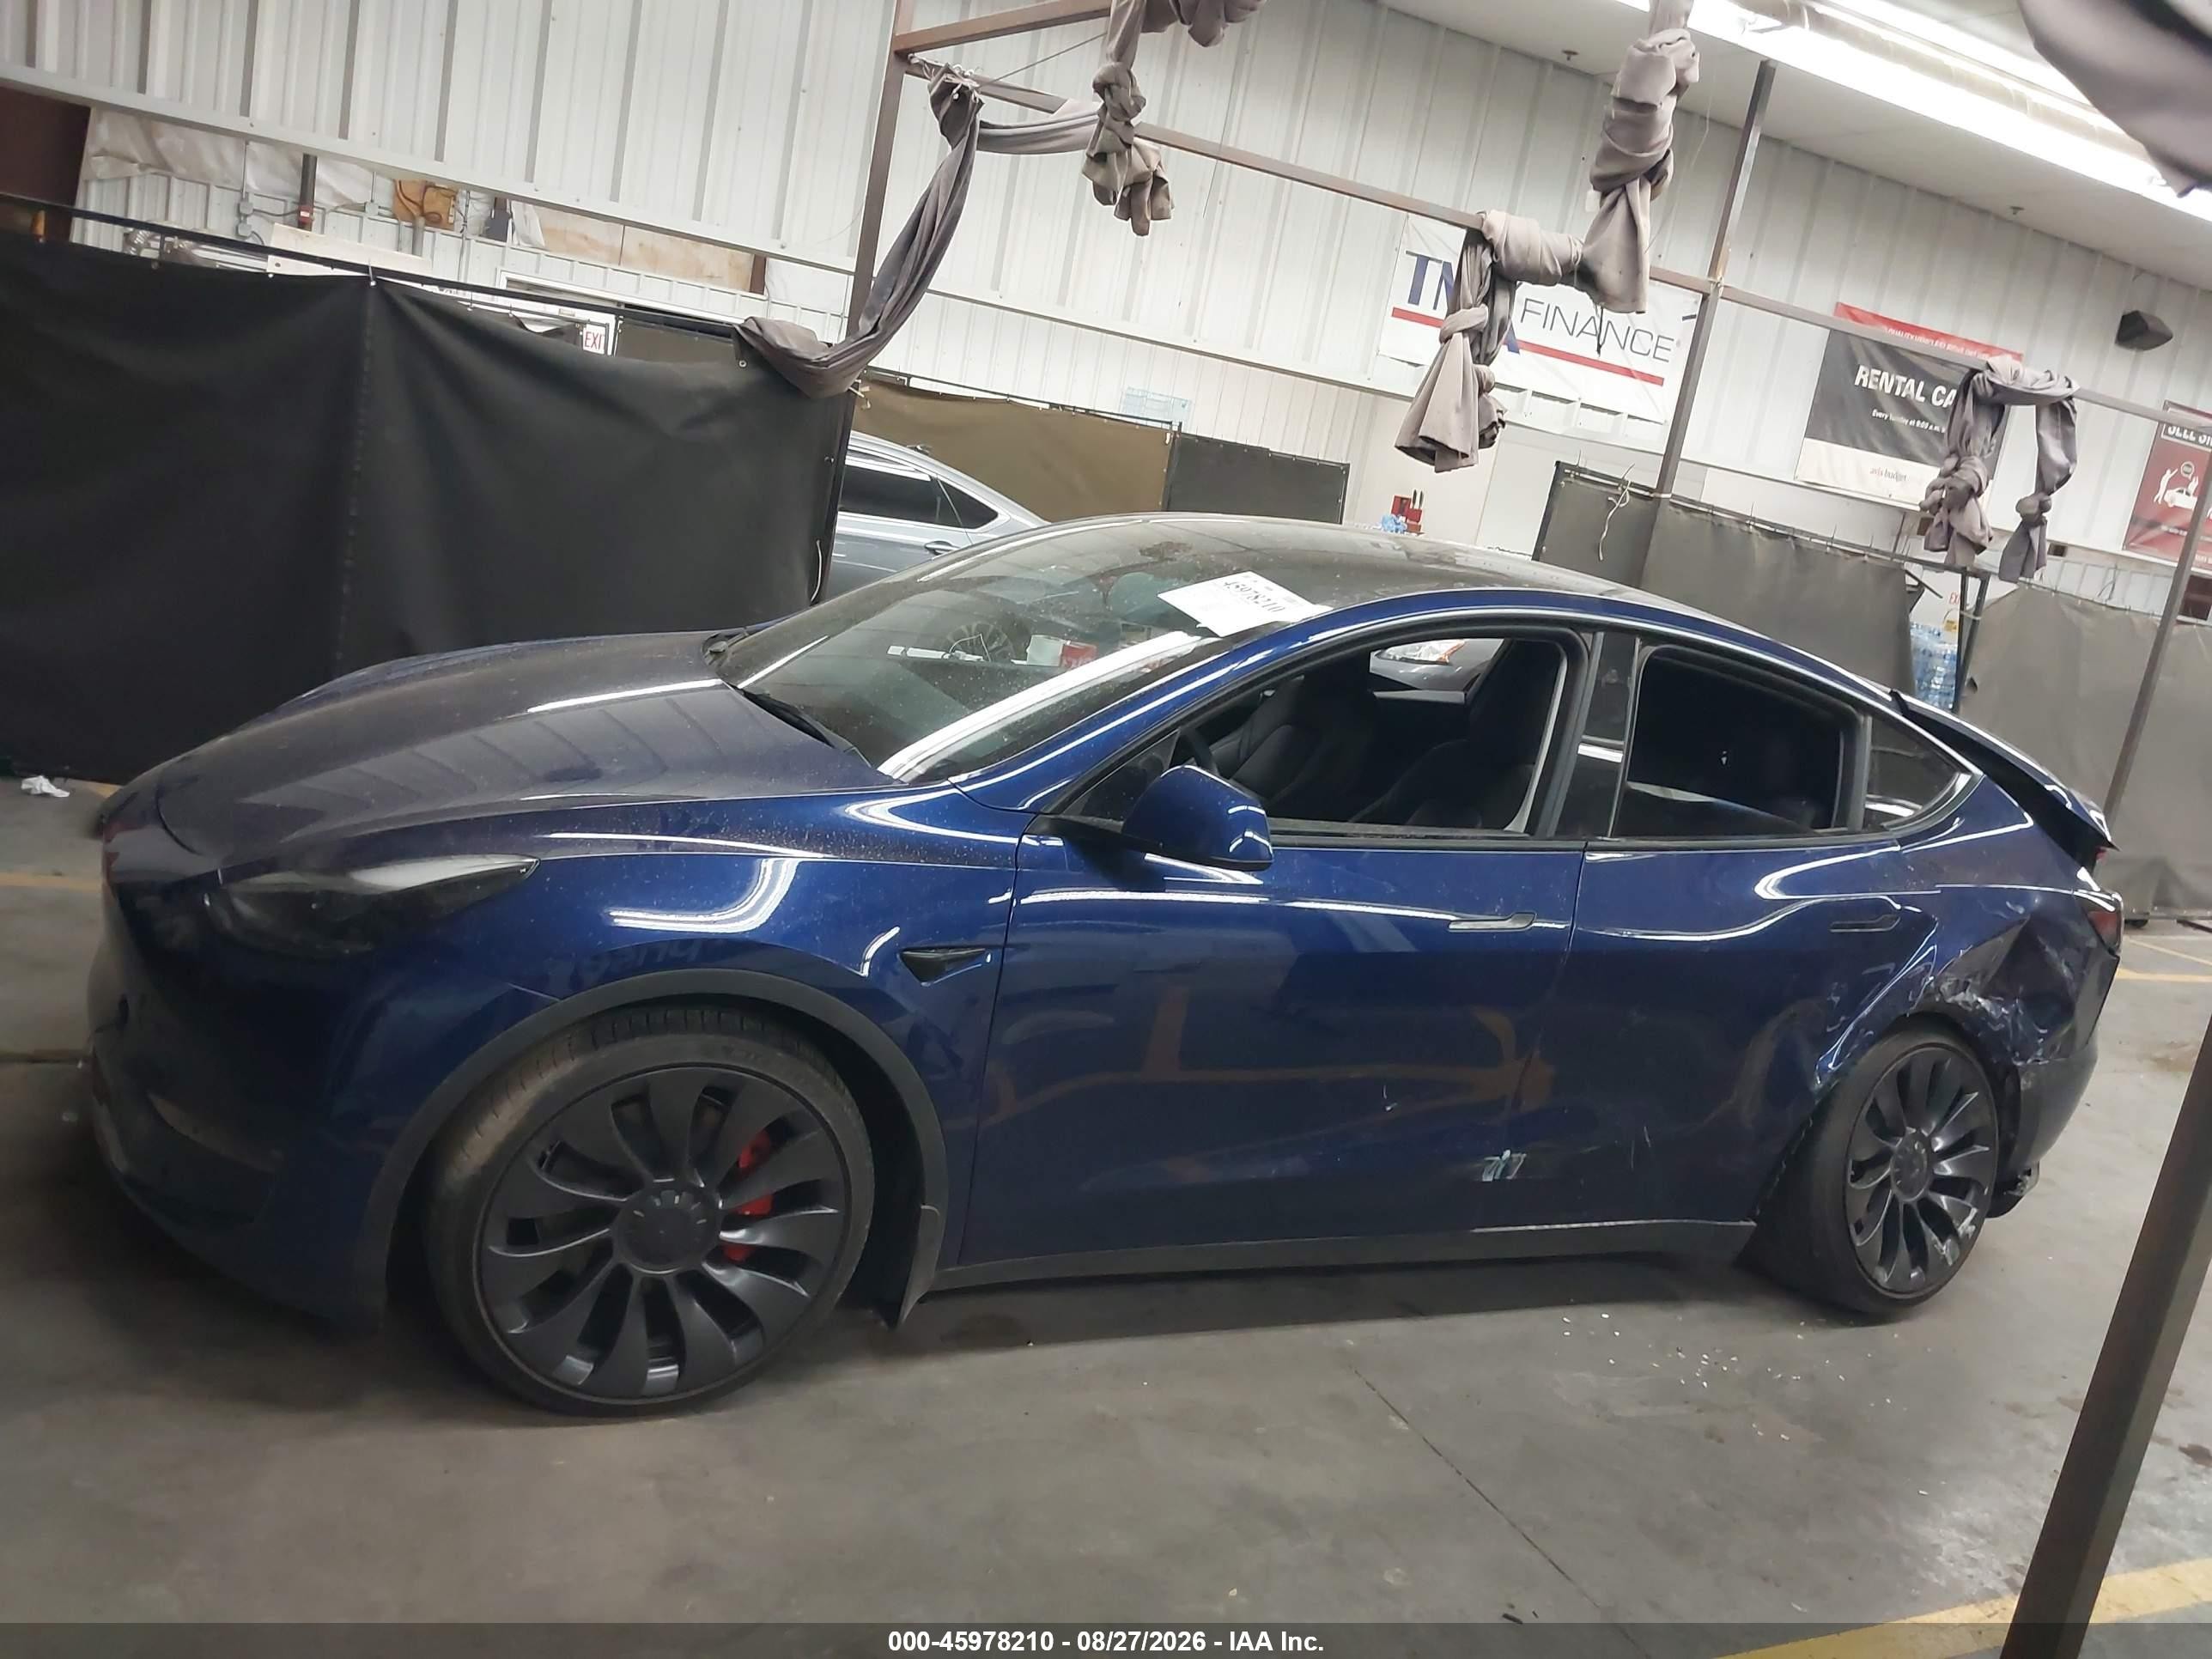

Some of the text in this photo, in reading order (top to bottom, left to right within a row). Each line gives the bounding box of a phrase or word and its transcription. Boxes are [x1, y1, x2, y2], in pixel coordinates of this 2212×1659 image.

[584, 331, 605, 350] EXI
[1521, 298, 1674, 362] FINANCE
[1855, 365, 1957, 408] RENTAL CA
[1872, 409, 1888, 420] Every
